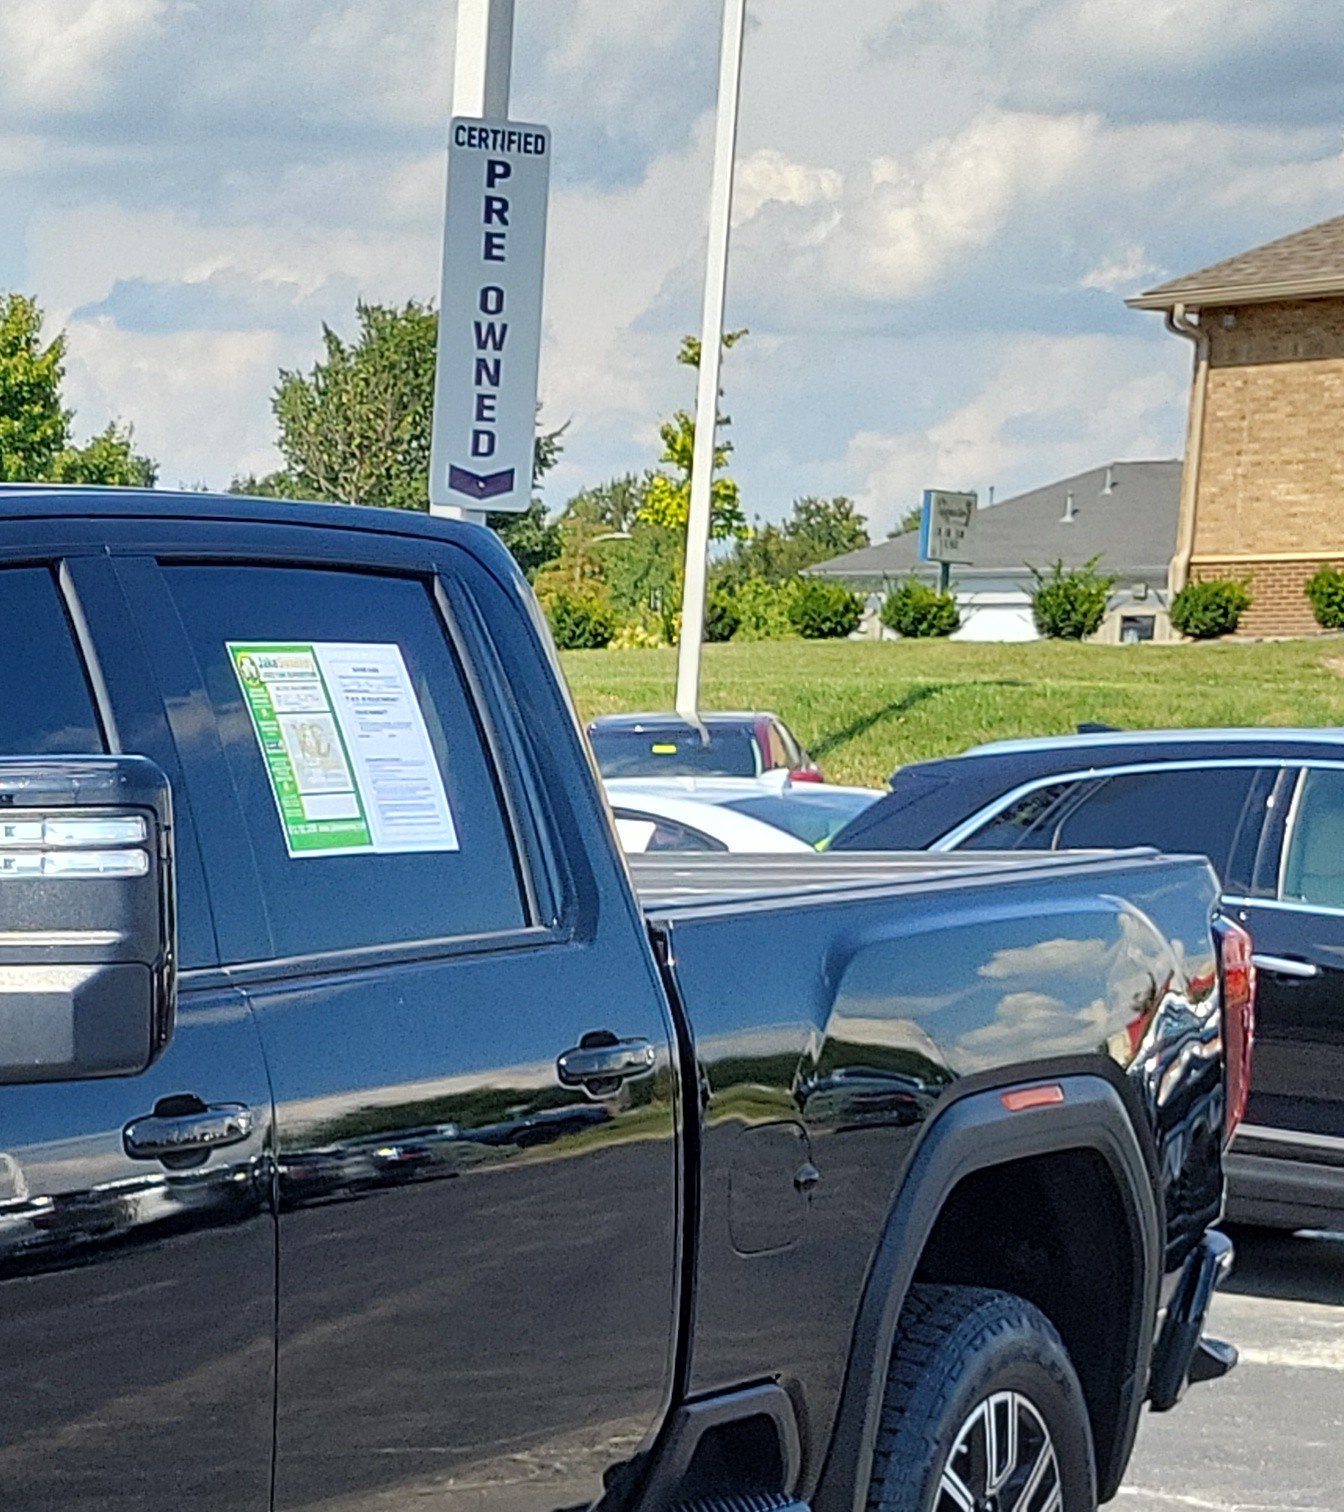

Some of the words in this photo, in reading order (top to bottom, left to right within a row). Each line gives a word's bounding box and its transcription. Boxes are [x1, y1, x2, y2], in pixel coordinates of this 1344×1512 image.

[454, 124, 547, 156] CERTIFIED
[482, 159, 512, 262] PRE
[470, 285, 509, 458] OWNED
